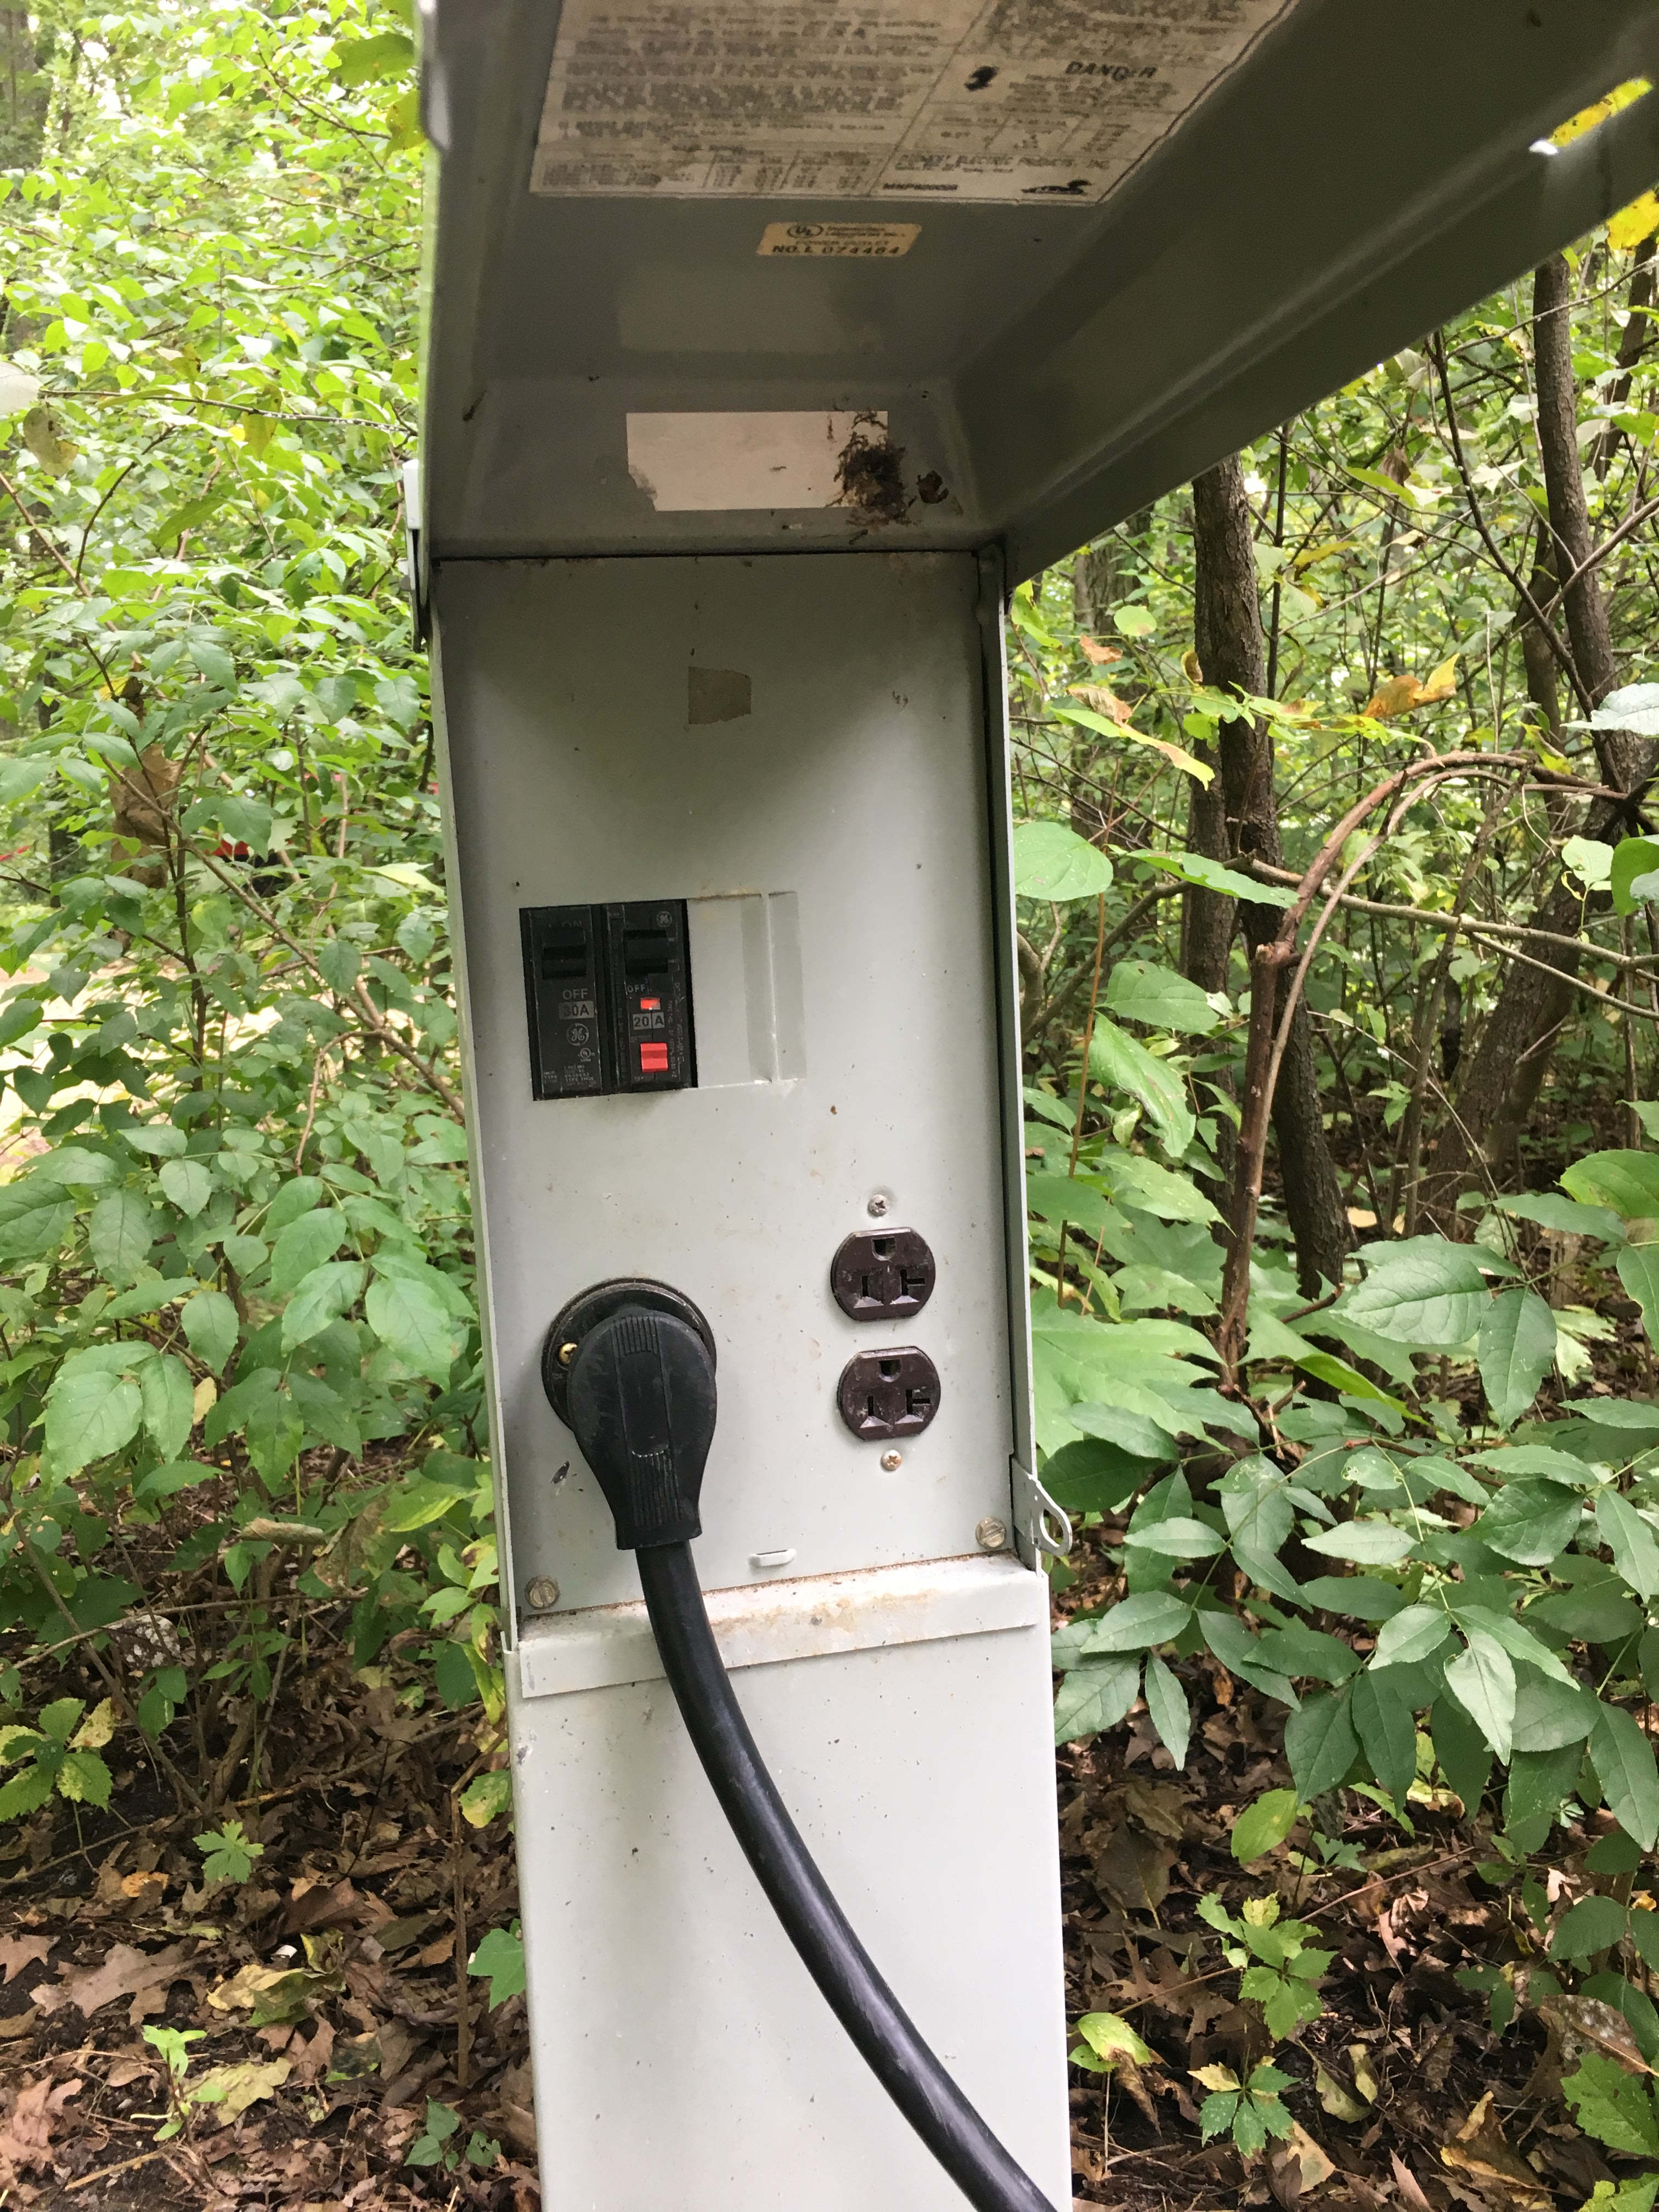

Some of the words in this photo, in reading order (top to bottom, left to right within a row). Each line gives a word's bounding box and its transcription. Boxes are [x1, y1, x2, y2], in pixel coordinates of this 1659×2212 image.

[562, 988, 588, 1000] OFF
[627, 984, 645, 992] OFF
[565, 1005, 589, 1017] 30A
